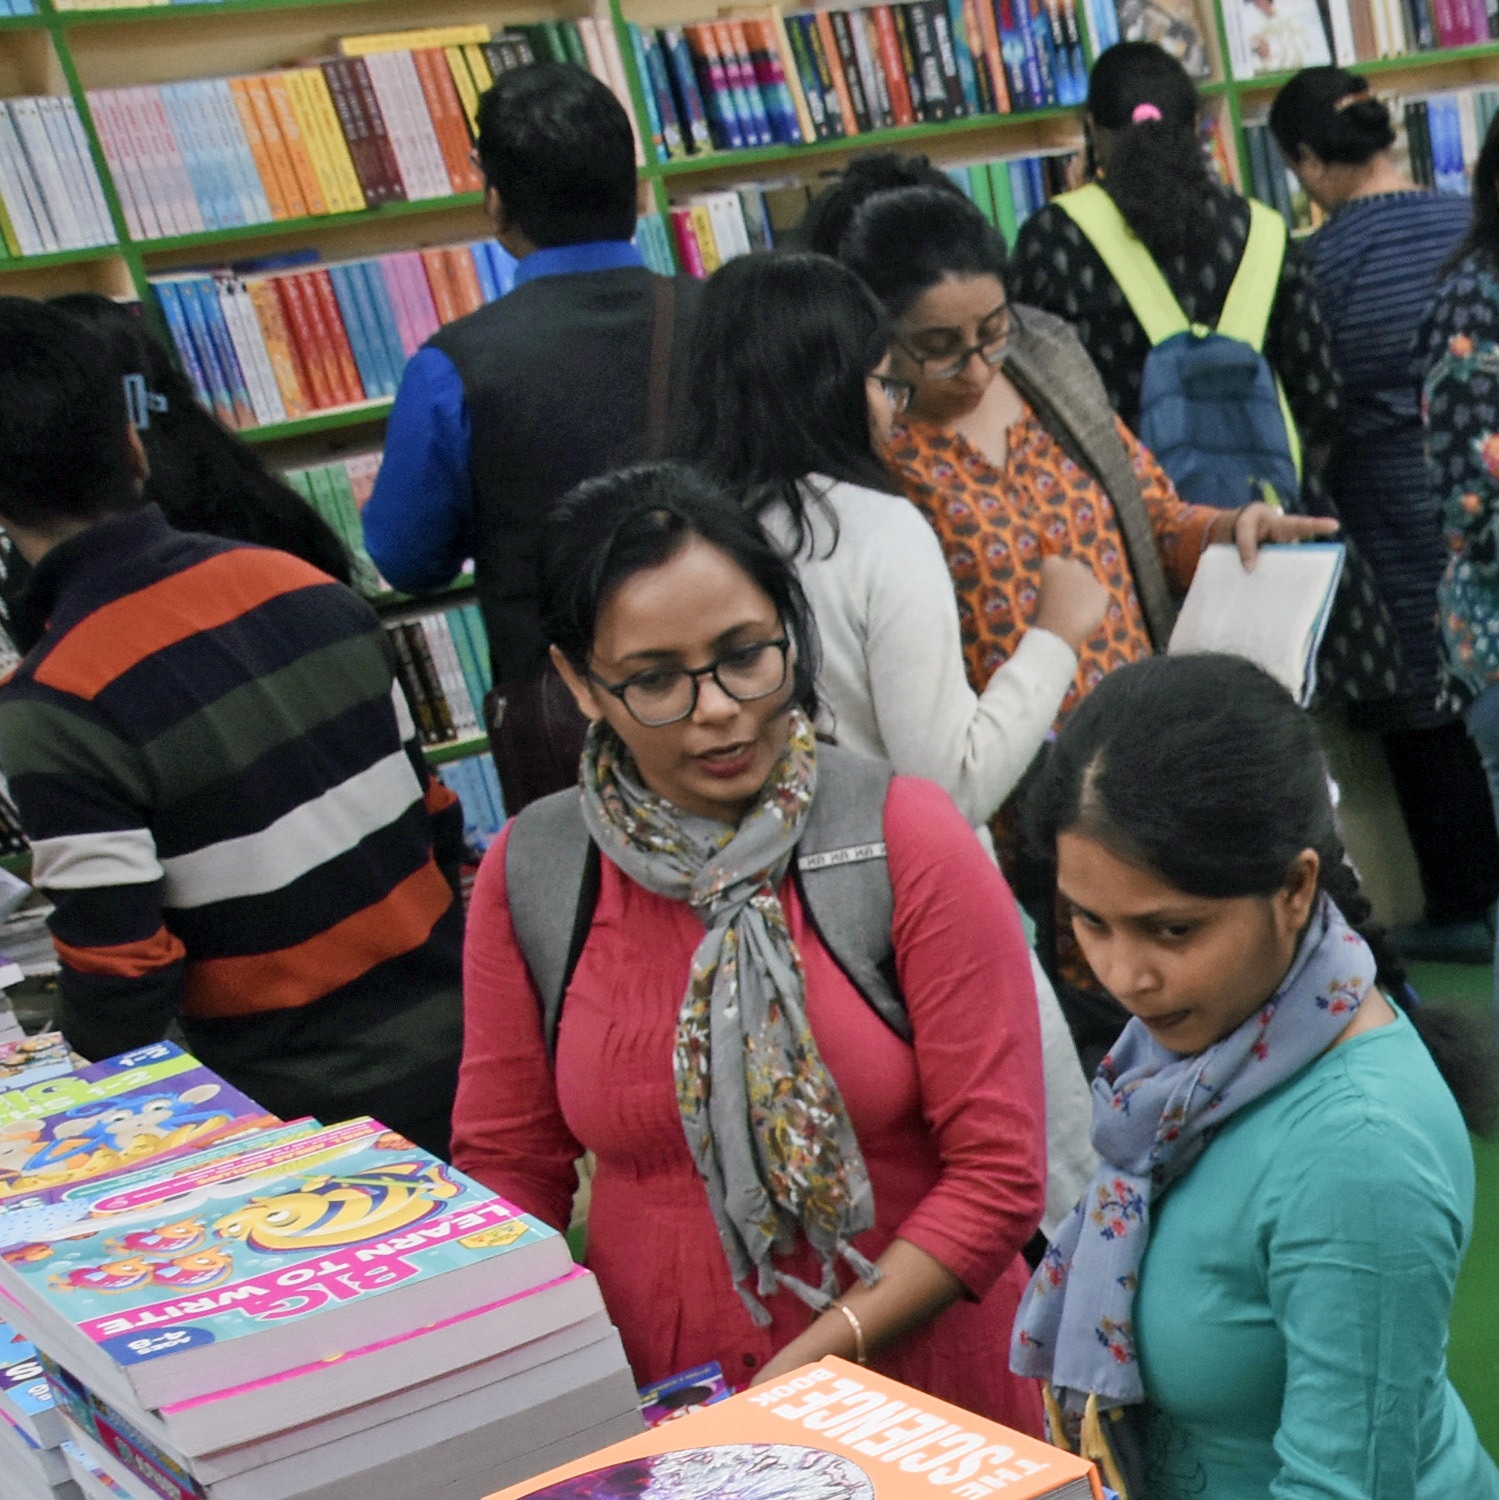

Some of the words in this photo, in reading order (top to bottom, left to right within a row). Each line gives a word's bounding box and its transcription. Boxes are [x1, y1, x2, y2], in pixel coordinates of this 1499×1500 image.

[355, 1203, 517, 1257] LEARN
[254, 1255, 420, 1321] BIG
[276, 1262, 350, 1286] TO
[96, 1282, 268, 1334] WRITE
[127, 1328, 187, 1350] 4-8
[749, 1368, 832, 1407] BOOK
[771, 1378, 1015, 1487] SCIENCE
[952, 1458, 1050, 1500] THE
